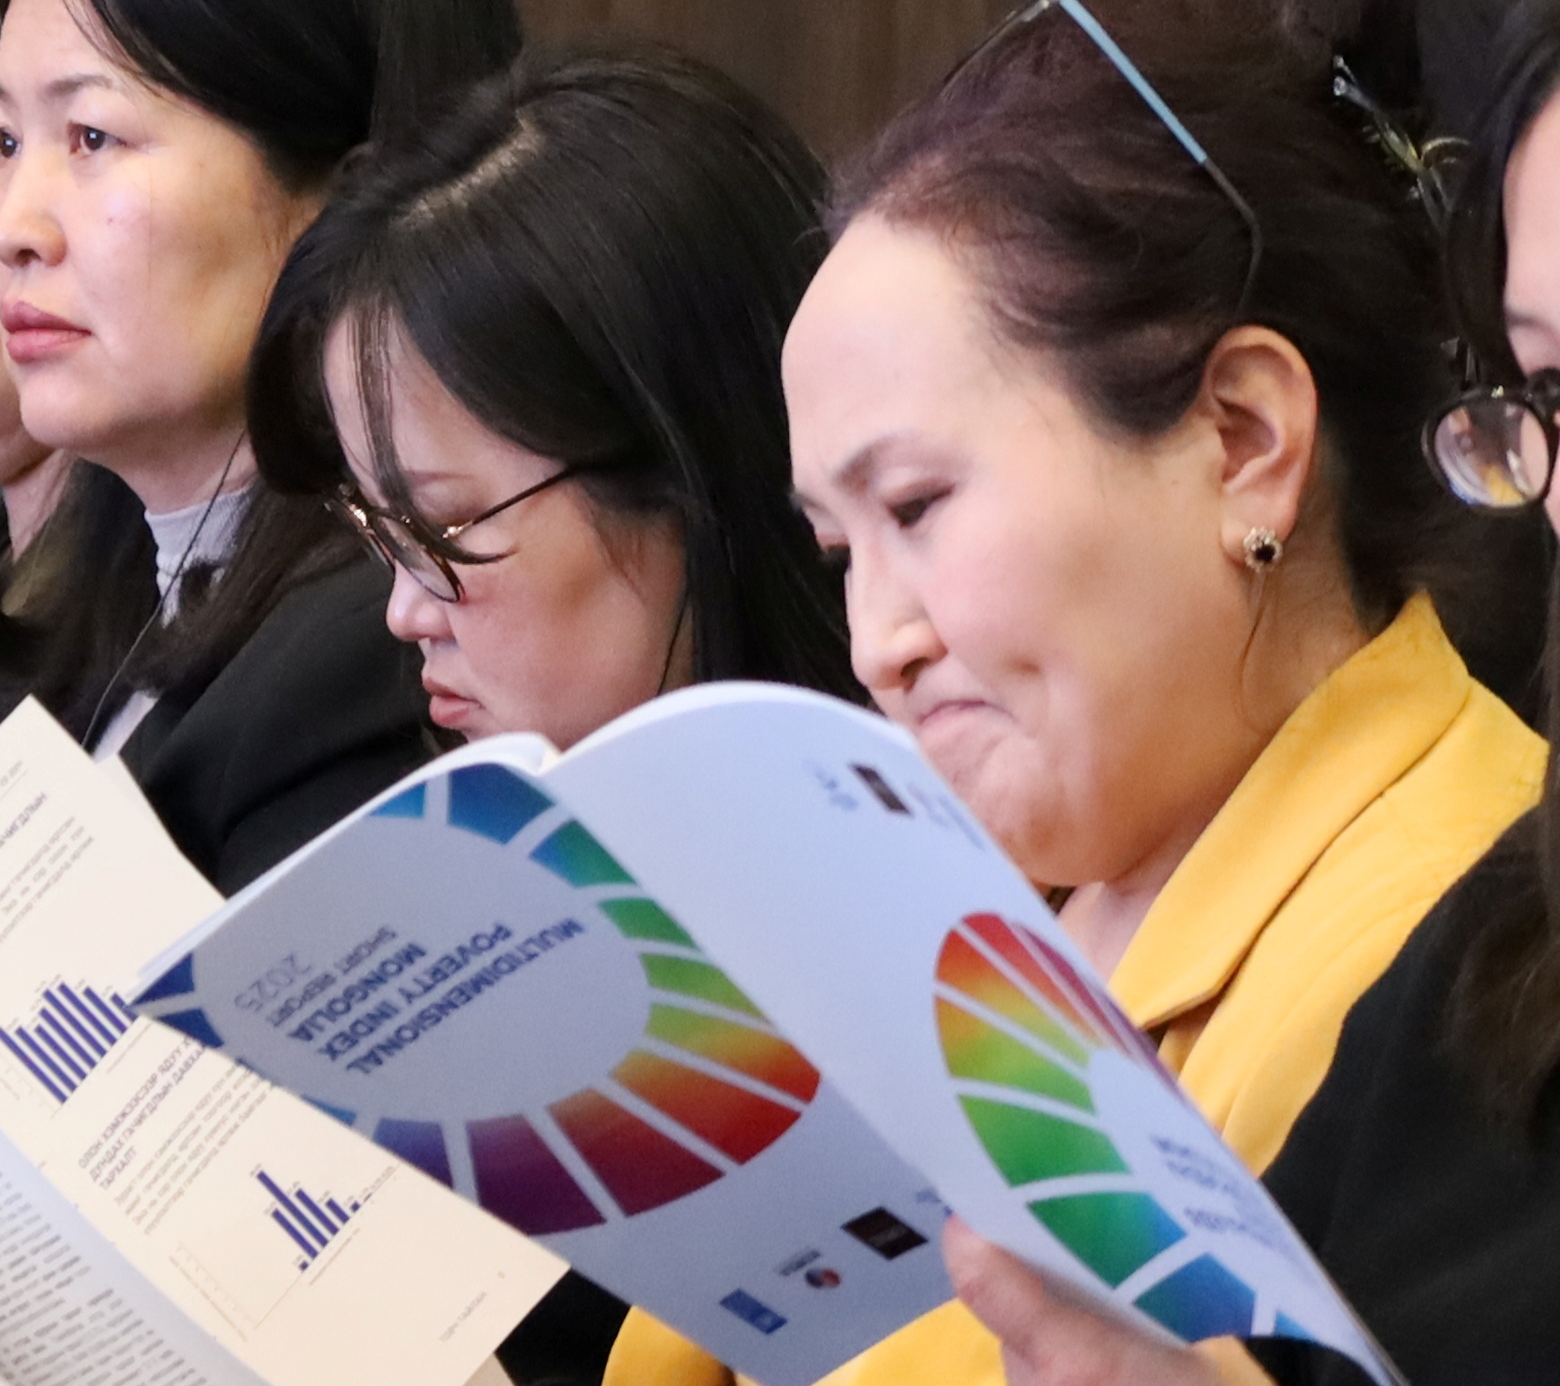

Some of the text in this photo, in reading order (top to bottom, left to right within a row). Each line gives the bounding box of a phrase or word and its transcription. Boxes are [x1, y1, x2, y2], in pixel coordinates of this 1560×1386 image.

[233, 954, 312, 1012] 2025
[268, 926, 397, 1027] SHORT REPORT
[289, 943, 426, 1043] MONGOLIA
[319, 924, 513, 1061] POVERTY INDEX
[347, 918, 585, 1075] MULTIDIMENSIONAL
[77, 1138, 104, 1169] ОЛОН
[87, 1137, 127, 1182] ДУНДАХ
[121, 1081, 175, 1142] ГАЧИГДЛЫН
[98, 1144, 139, 1191] ТАРХАЛТ
